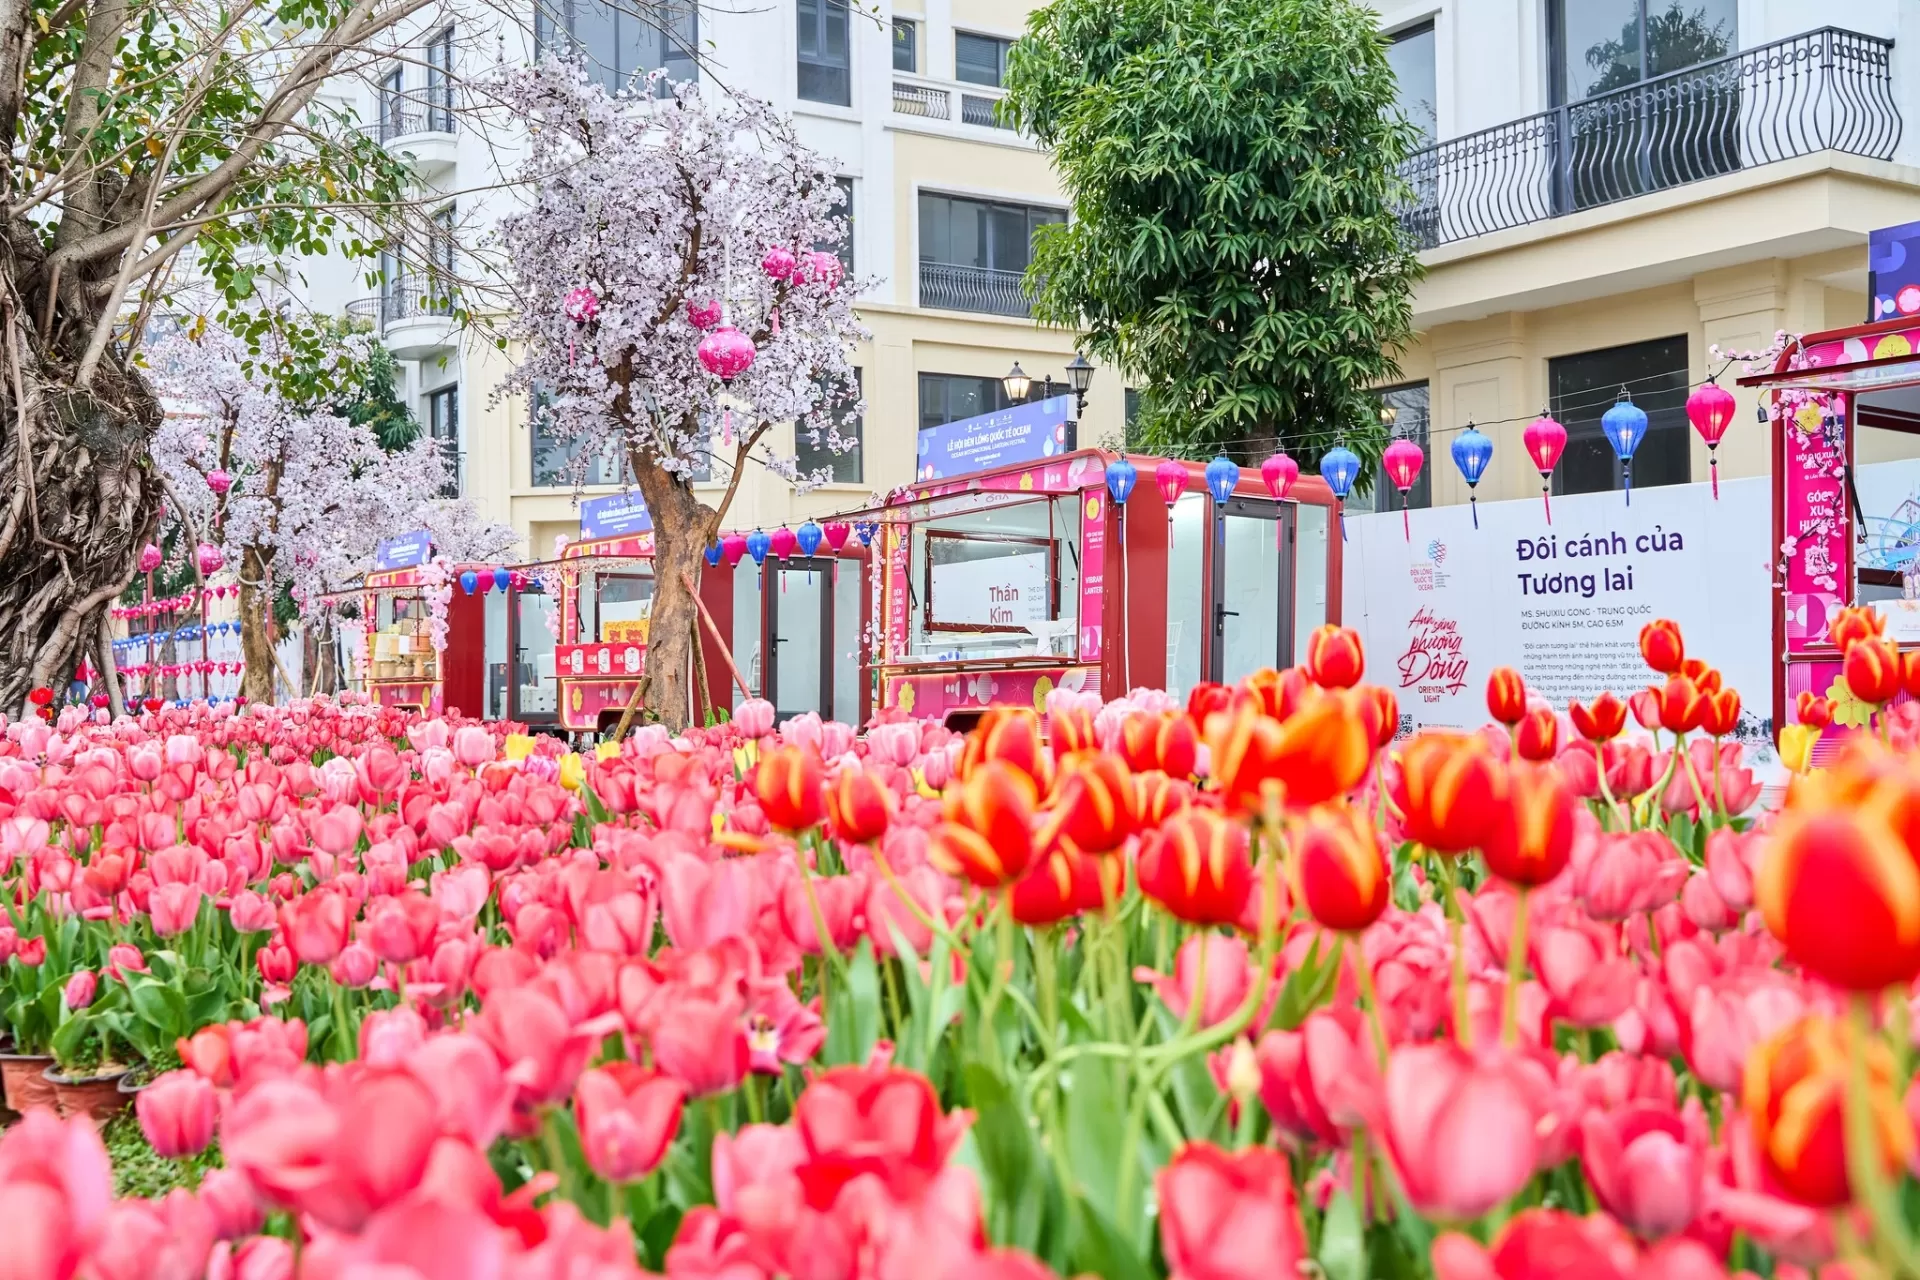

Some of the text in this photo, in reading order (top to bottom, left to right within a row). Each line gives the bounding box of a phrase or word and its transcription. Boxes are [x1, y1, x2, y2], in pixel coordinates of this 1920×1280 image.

[990, 428, 1004, 443] QUỐC
[1012, 424, 1032, 437] OCEAN
[1516, 525, 1684, 561] Đôi cánh của
[1518, 565, 1633, 598] Tương lai
[989, 583, 1019, 603] Thần
[990, 606, 1013, 624] Kim
[1521, 610, 1534, 618] MS.
[1536, 609, 1566, 617] SHUIXIU
[1567, 608, 1591, 616] GONG
[1597, 607, 1625, 616] TRUNG
[1627, 604, 1652, 615] QUỐC
[1552, 619, 1570, 629] KÍNH
[1587, 619, 1604, 628] CAO
[1397, 649, 1469, 696] Đông
[1418, 686, 1445, 694] ORIENTAL
[1424, 695, 1440, 703] LIGHT
